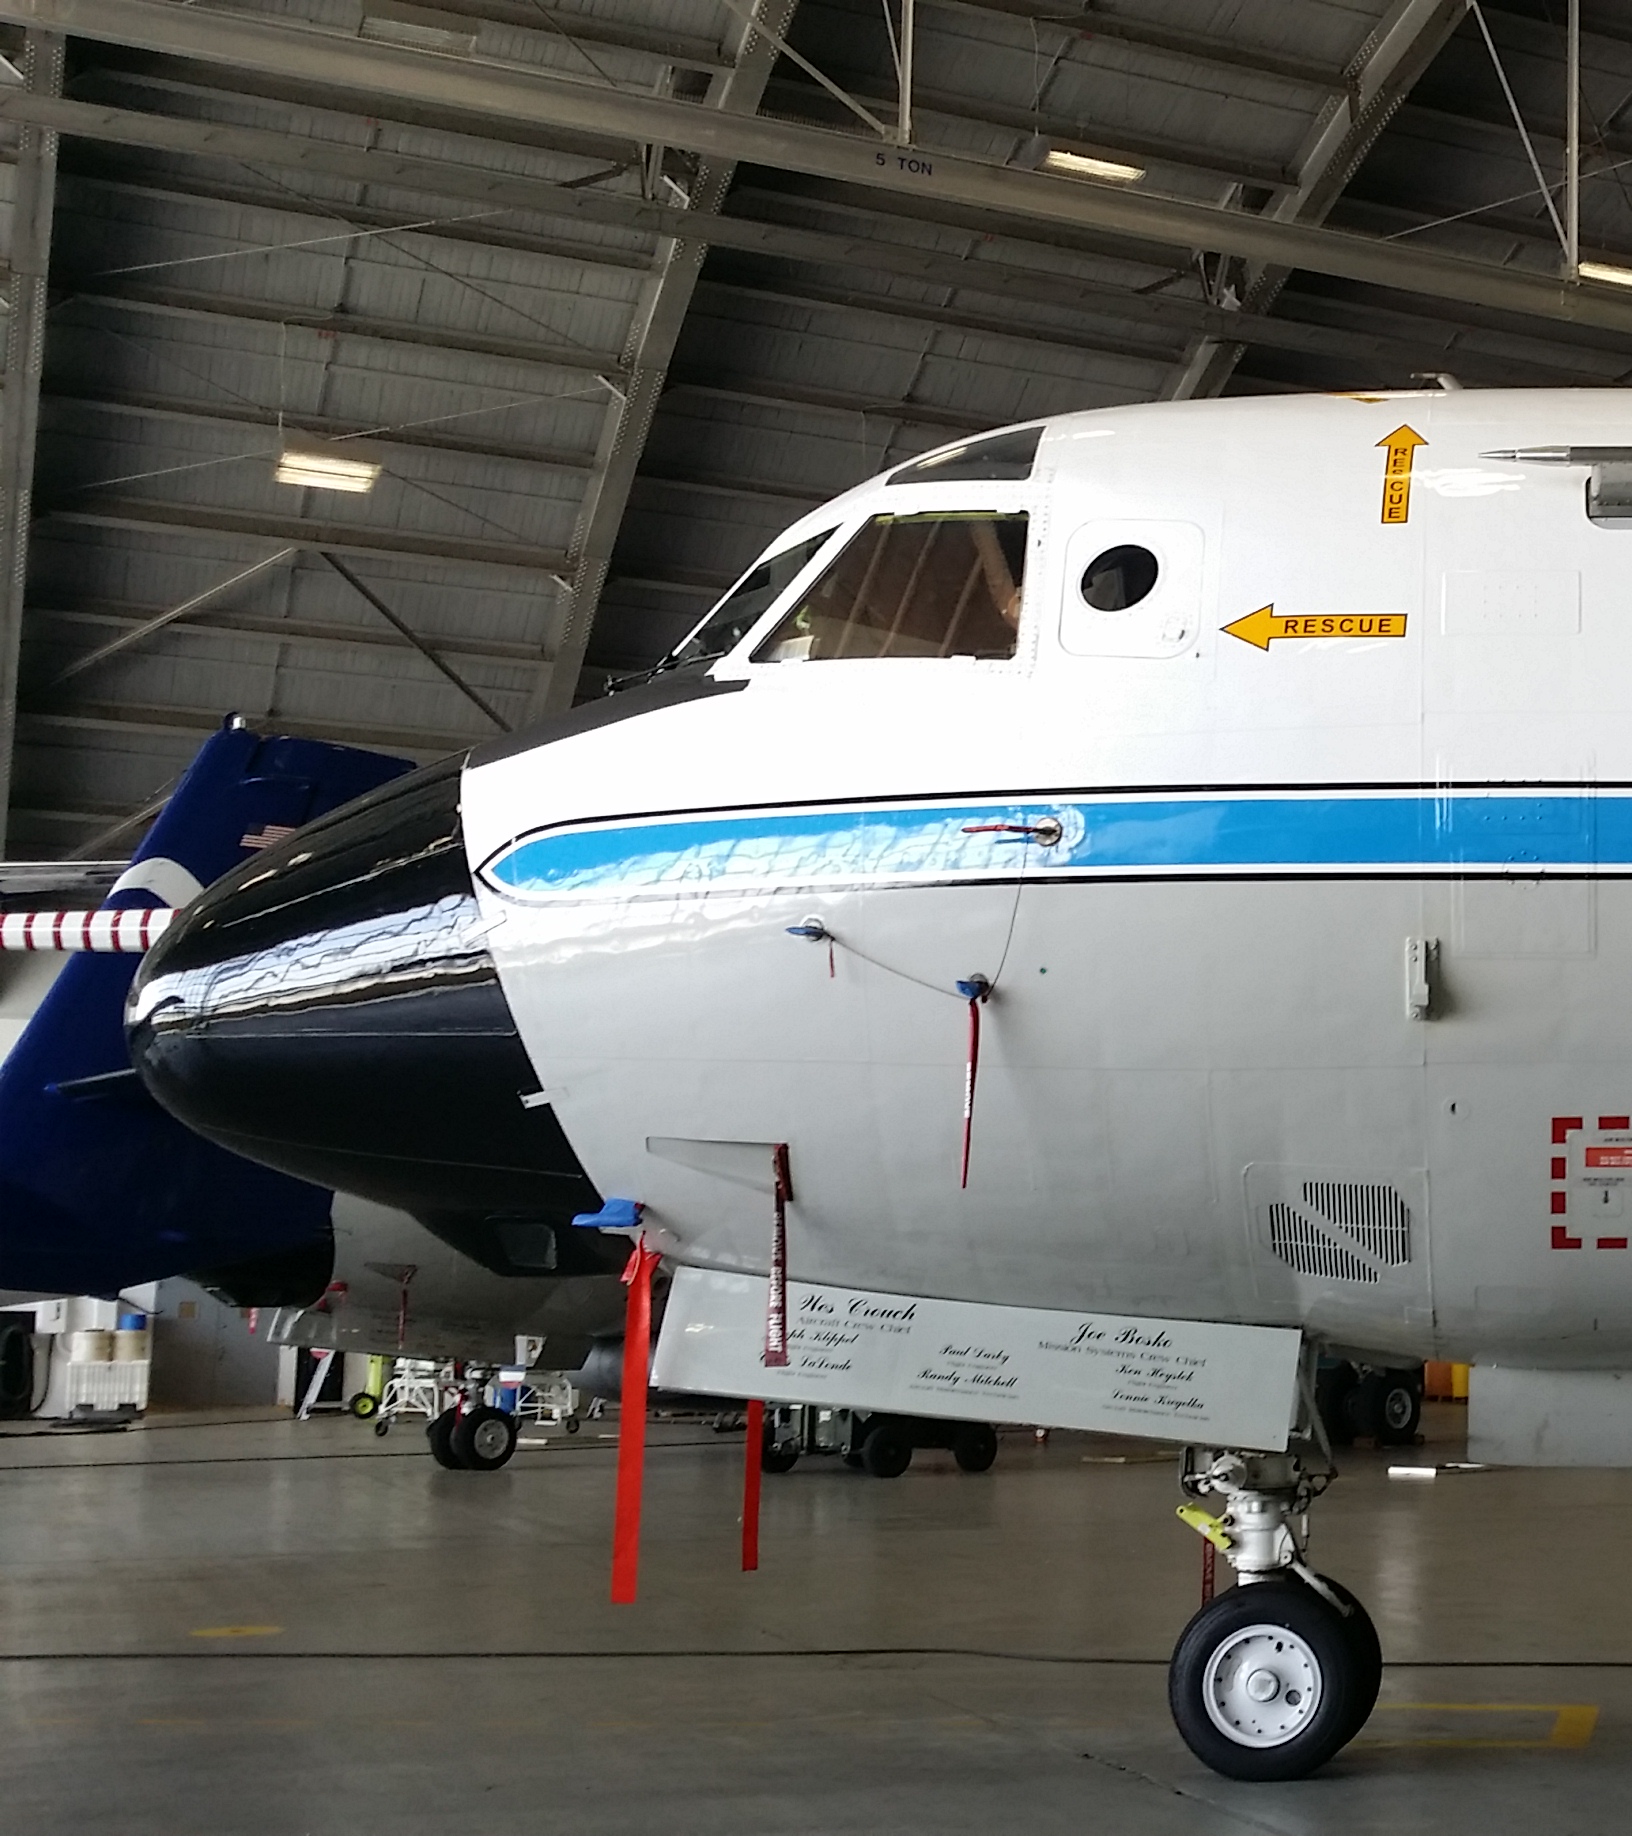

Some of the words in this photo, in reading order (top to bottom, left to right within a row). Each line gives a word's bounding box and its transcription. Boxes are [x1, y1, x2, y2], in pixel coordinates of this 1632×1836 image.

[876, 152, 886, 166] 5
[897, 156, 932, 176] TON
[1388, 448, 1408, 518] RESCUE
[1284, 618, 1392, 634] RESCUE
[769, 1266, 783, 1308] BEFORE
[800, 1294, 835, 1314] Wes
[848, 1297, 917, 1321] Crouch
[768, 1313, 783, 1353] FLIGHT
[1069, 1322, 1106, 1344] Joe
[1114, 1327, 1172, 1347] Bosko
